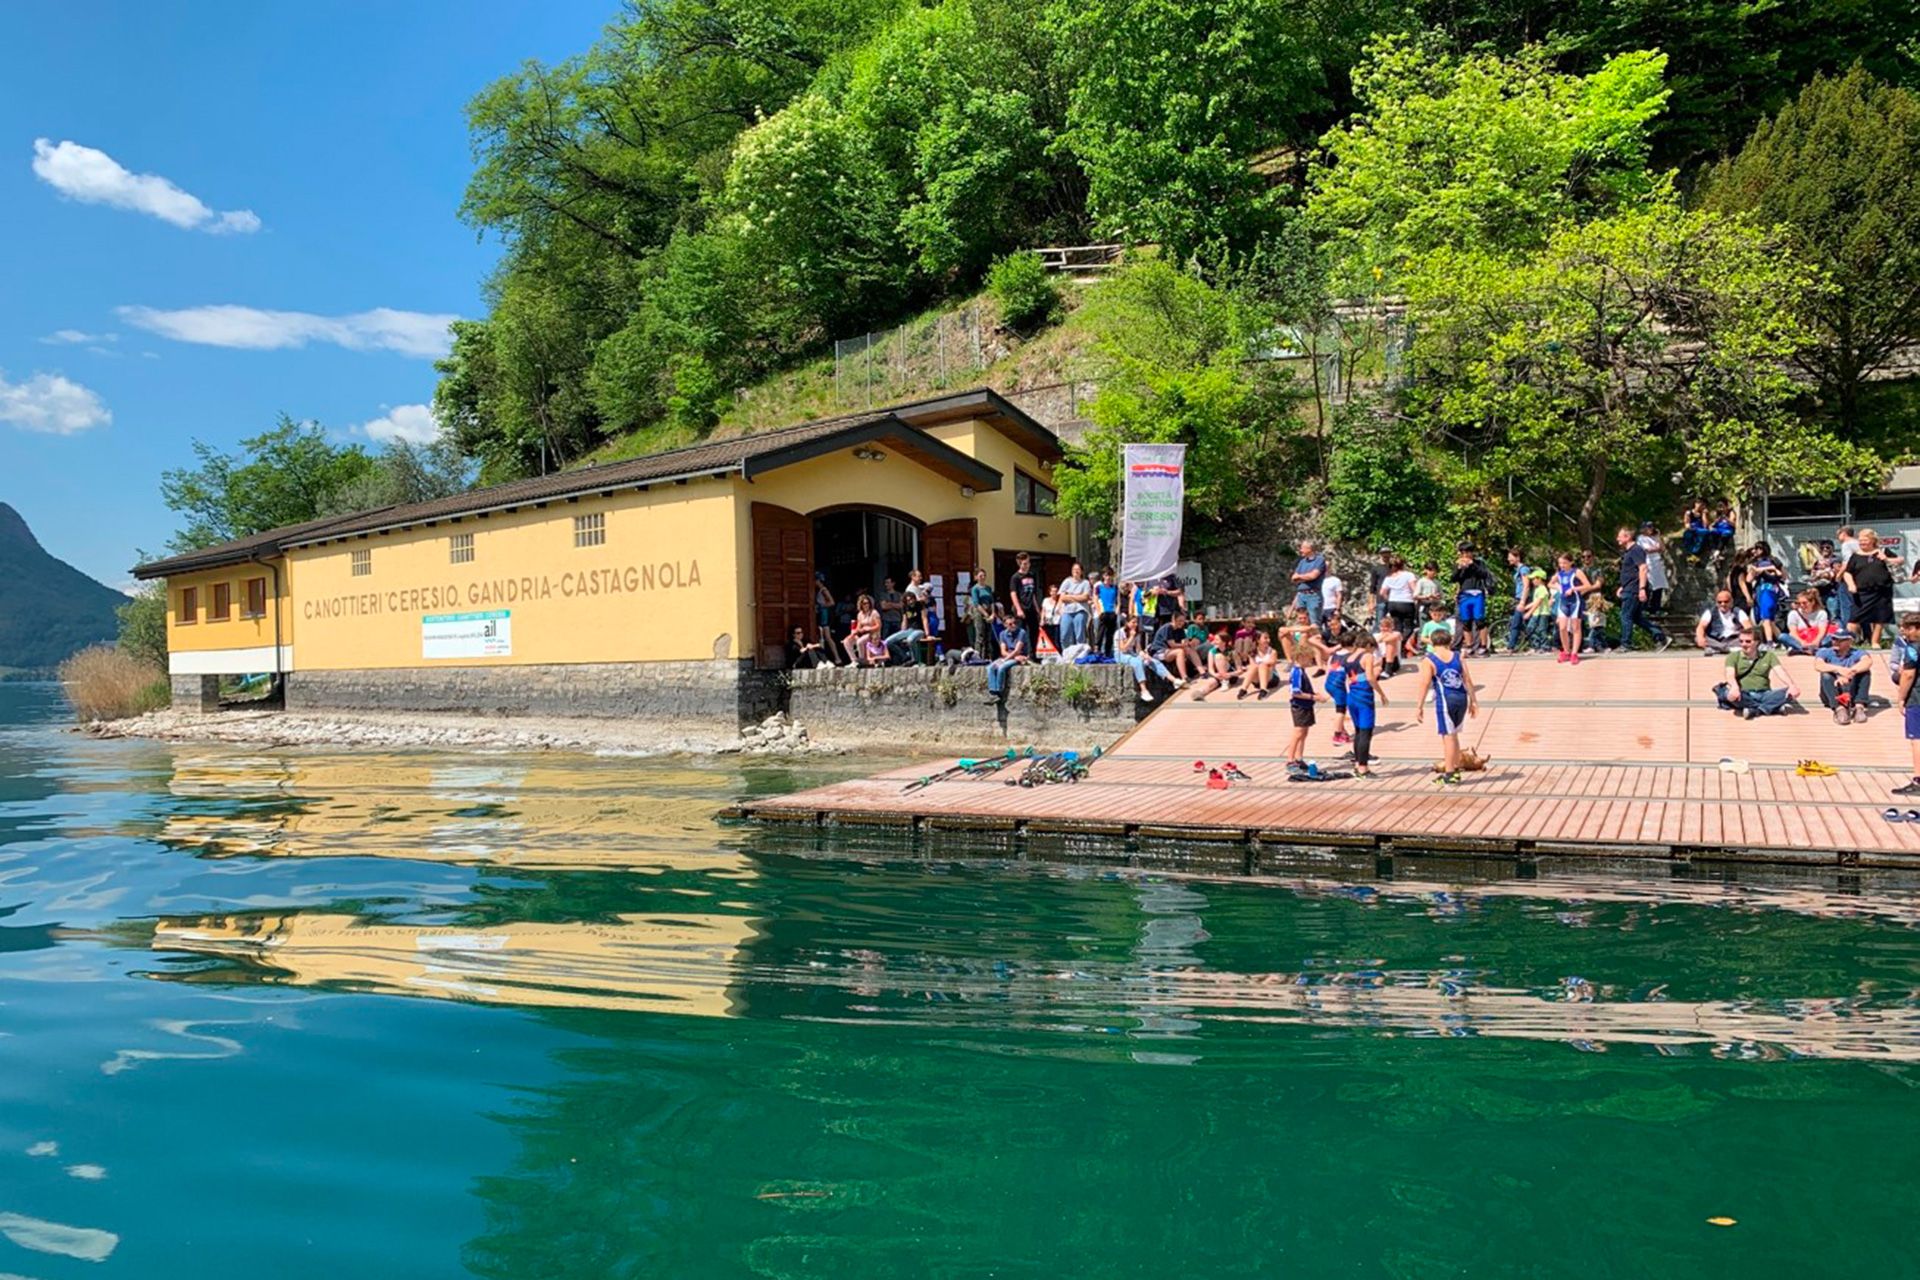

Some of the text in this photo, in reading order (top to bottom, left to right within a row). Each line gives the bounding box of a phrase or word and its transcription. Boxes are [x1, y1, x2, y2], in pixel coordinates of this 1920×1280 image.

[1130, 511, 1178, 521] CERESIO
[304, 593, 383, 620] CANOTTIERI
[468, 559, 702, 605] GANDRIA-CASTAGNOLA
[484, 619, 496, 637] ail
